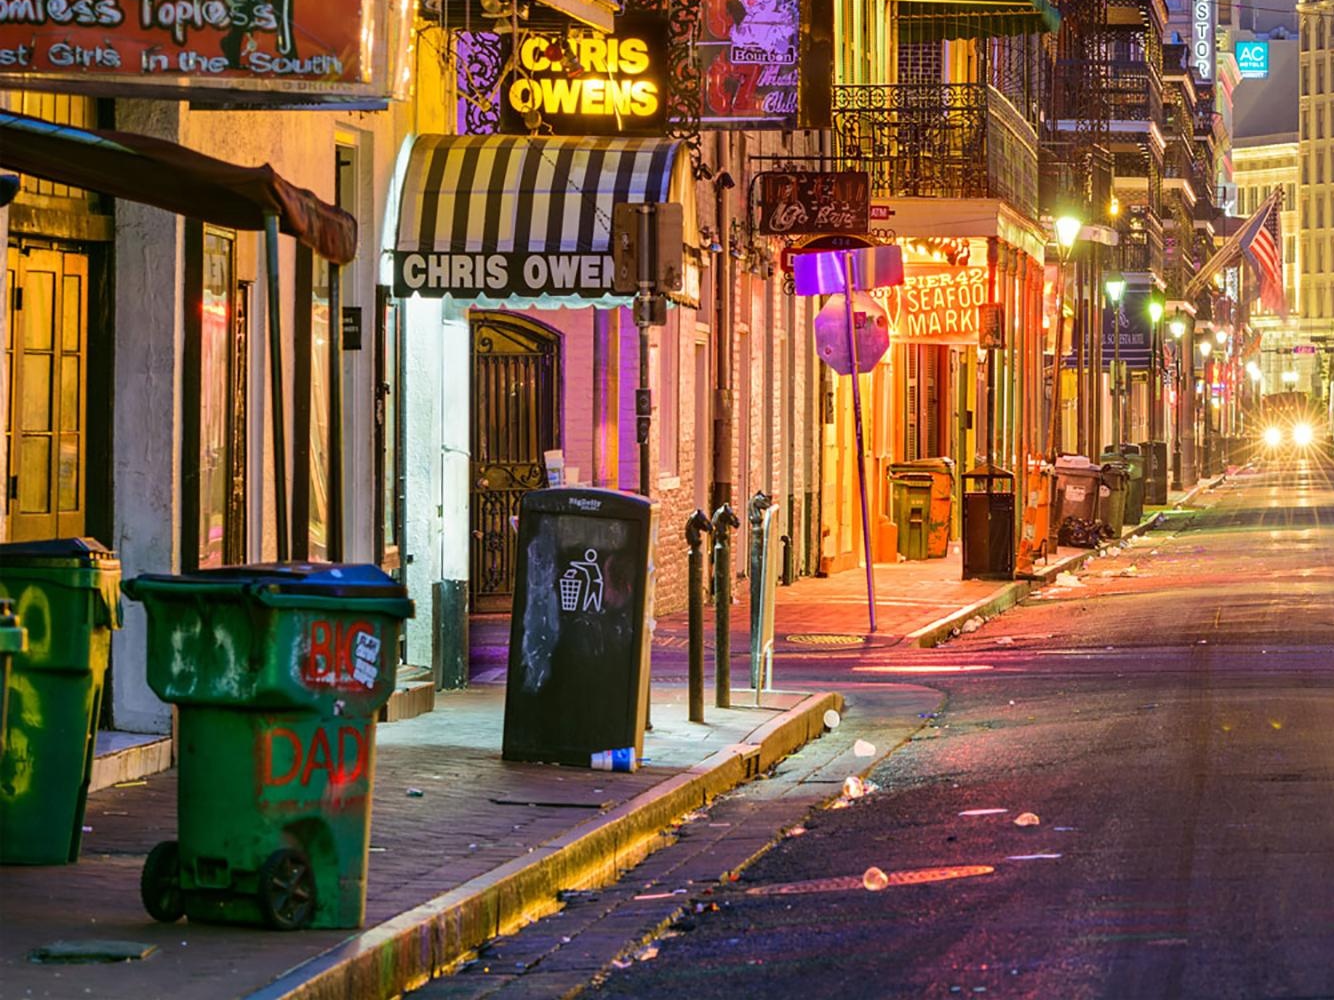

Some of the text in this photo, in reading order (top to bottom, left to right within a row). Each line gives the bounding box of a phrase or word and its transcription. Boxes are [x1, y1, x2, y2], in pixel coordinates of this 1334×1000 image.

[48, 42, 122, 68] Girls
[178, 49, 229, 75] the
[248, 52, 344, 76] South
[1239, 45, 1265, 62] AC
[508, 78, 659, 117] OWENS
[402, 254, 509, 289] CHRIS
[903, 273, 955, 290] PIER
[907, 283, 985, 313] SEAFOO
